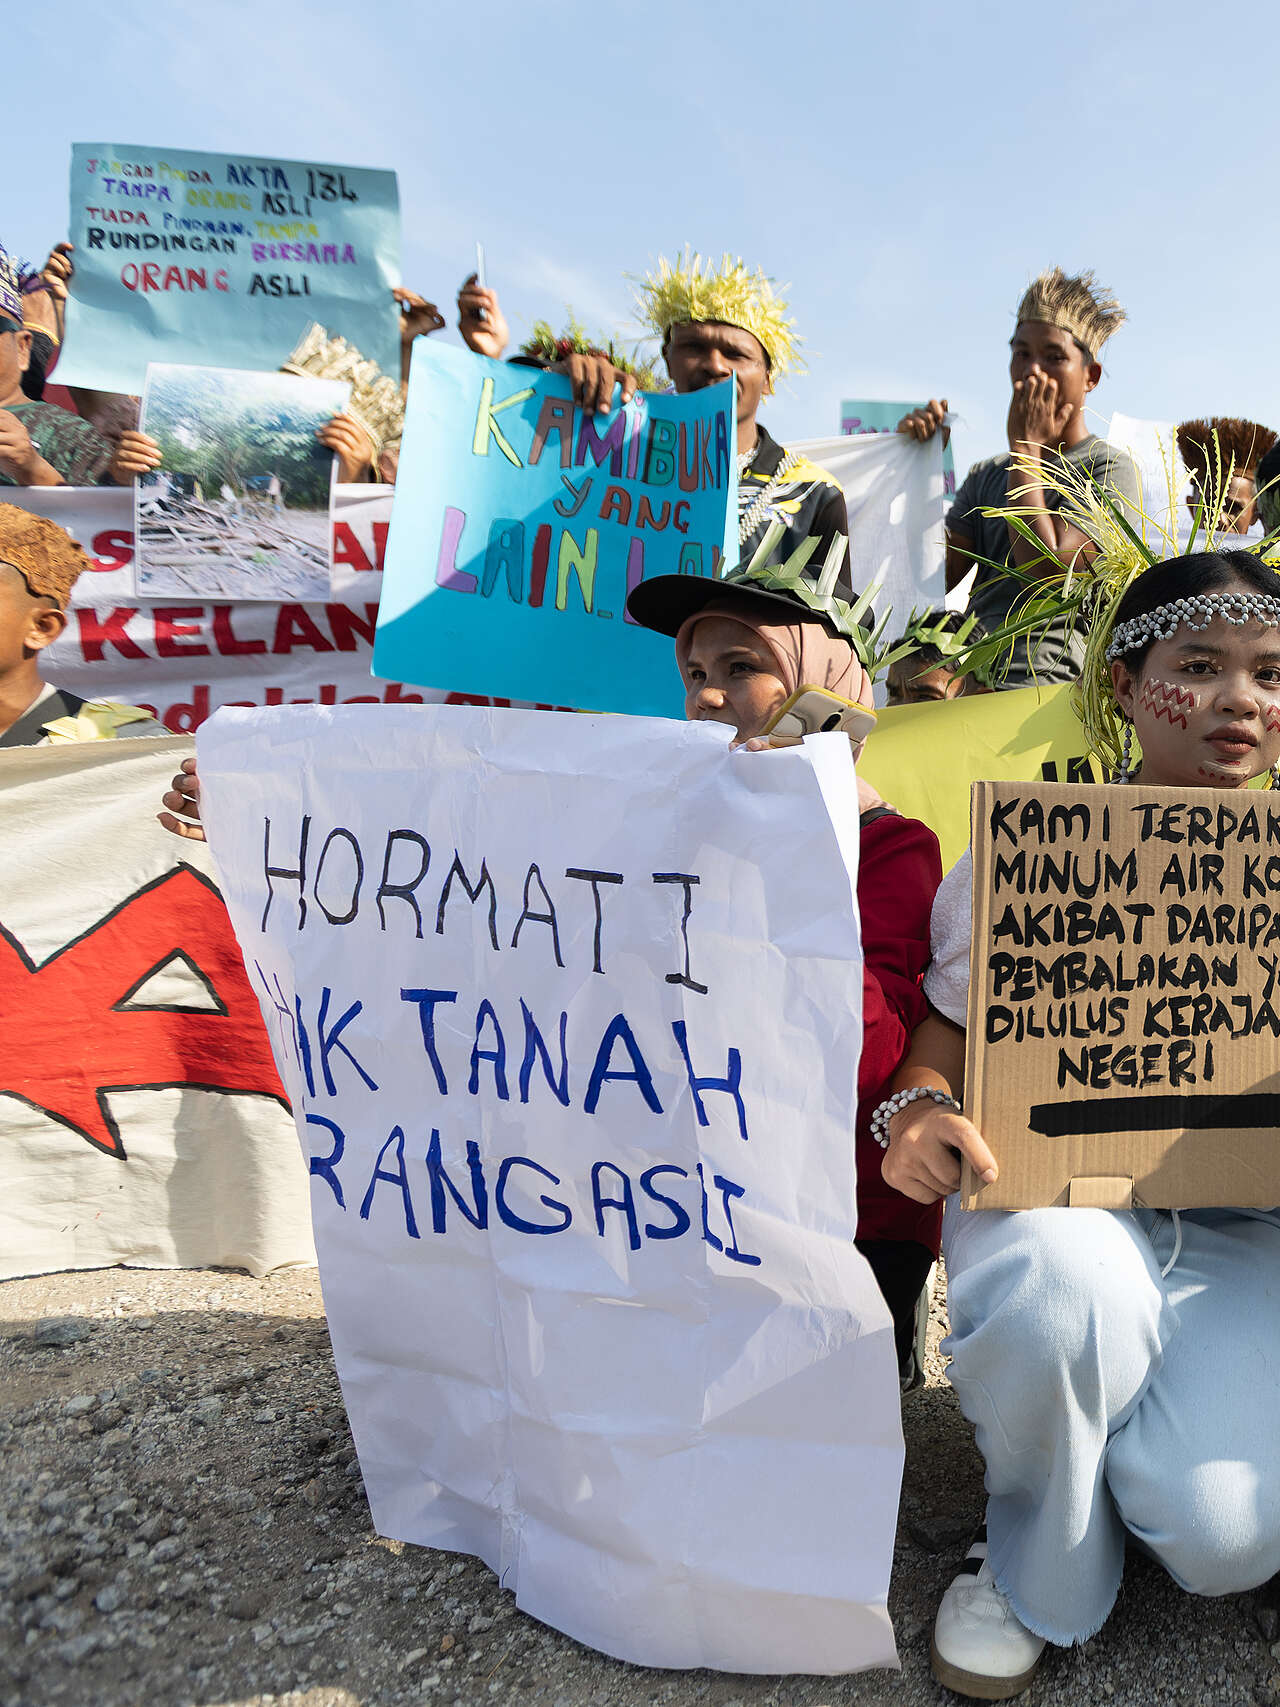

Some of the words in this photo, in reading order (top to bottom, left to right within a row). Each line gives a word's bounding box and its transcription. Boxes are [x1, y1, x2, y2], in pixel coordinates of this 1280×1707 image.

[103, 178, 172, 201] TANPA
[187, 189, 252, 211] ORANG
[262, 193, 312, 217] ASLI
[226, 163, 289, 190] AKTA
[87, 227, 236, 253] RUNDINGAN
[252, 243, 356, 264] BERSAMA
[254, 221, 319, 239] TANPA
[121, 263, 229, 292] ORANG
[250, 274, 310, 297] ASLI
[641, 410, 733, 492] BUKA
[75, 602, 380, 664] KELAN
[989, 798, 1110, 846] KAMI
[994, 848, 1138, 898] MINUM
[1160, 852, 1224, 898] AIR
[993, 902, 1155, 947] AKIBAT
[988, 950, 1238, 1000] PEMBALAKAN
[986, 998, 1129, 1044] DILULUS
[400, 986, 749, 1141] TANAH
[1057, 1039, 1214, 1090] NEGERI
